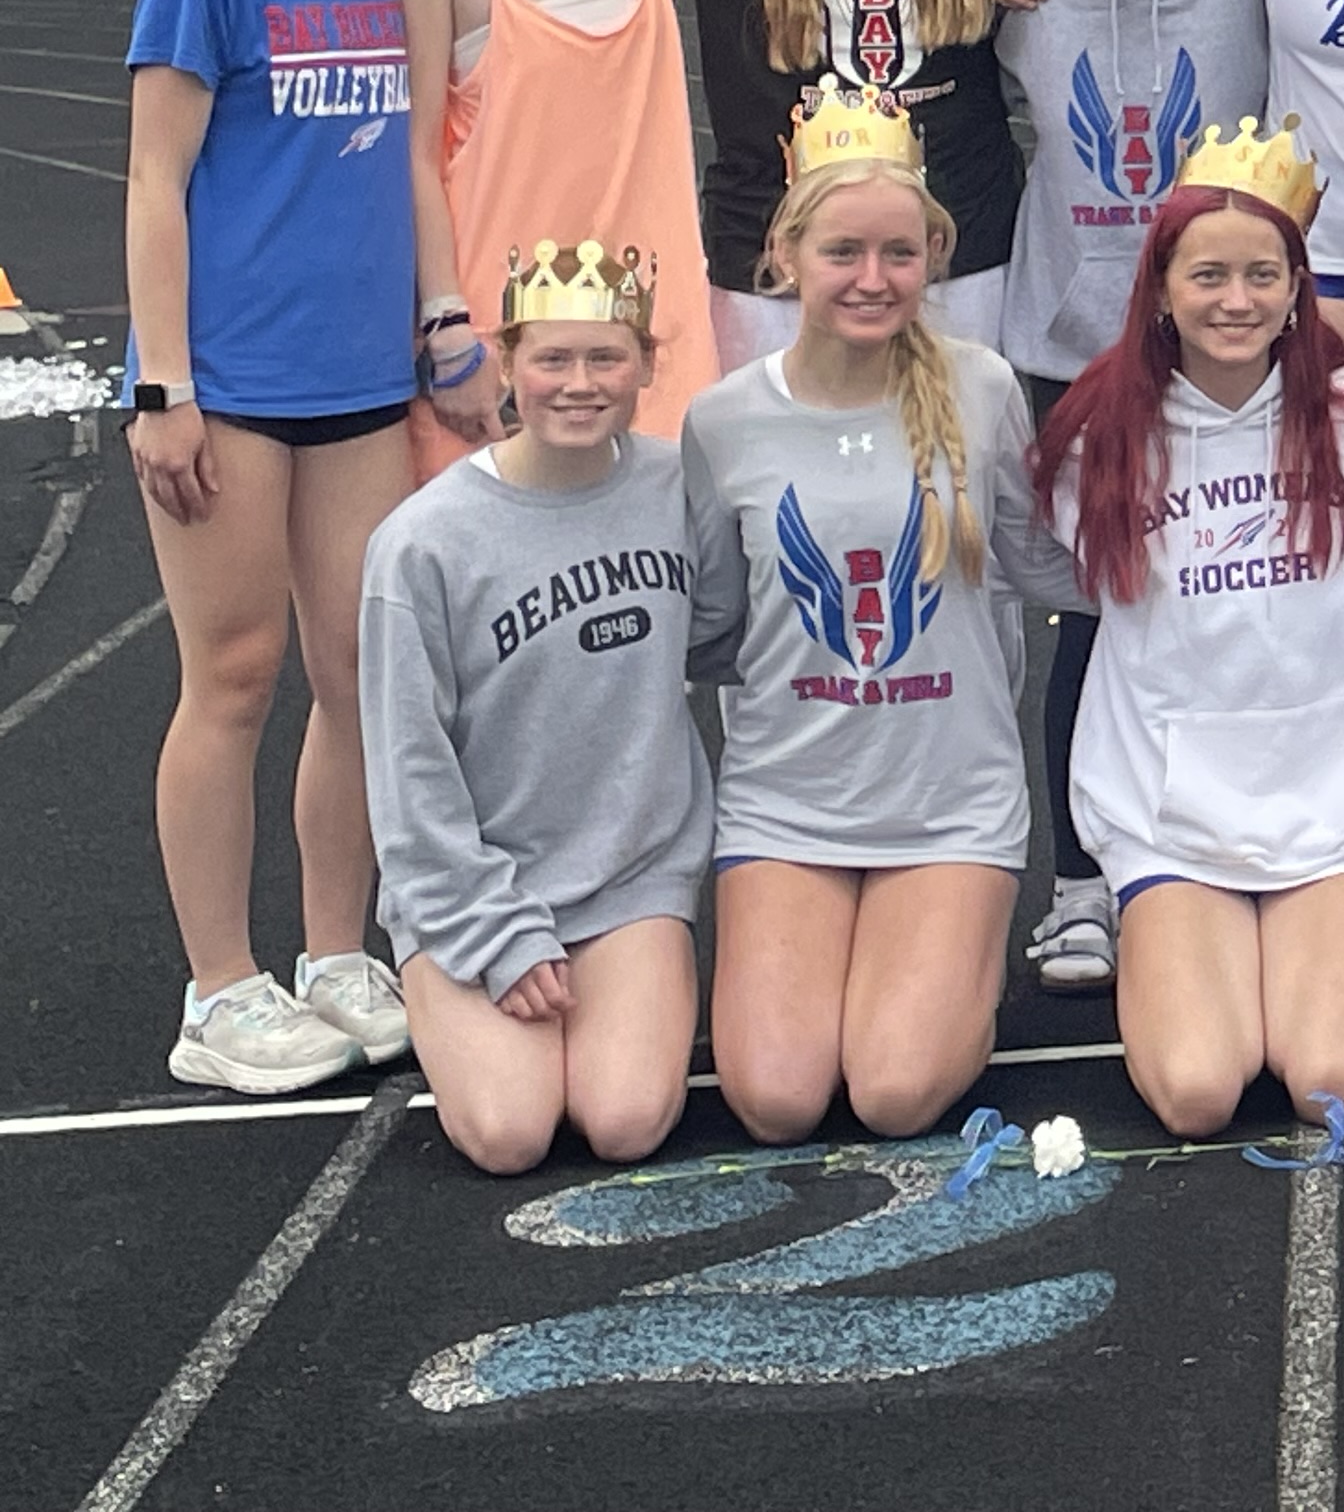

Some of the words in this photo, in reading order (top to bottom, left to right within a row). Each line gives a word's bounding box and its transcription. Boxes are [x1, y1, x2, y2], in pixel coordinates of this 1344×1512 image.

[264, 4, 328, 56] BAY
[1122, 105, 1153, 195] BAY
[1193, 528, 1215, 549] 20
[1179, 551, 1317, 598] SOCCER
[590, 614, 639, 647] 1946
[843, 548, 885, 667] BAY
[407, 1134, 1122, 1413] 2
